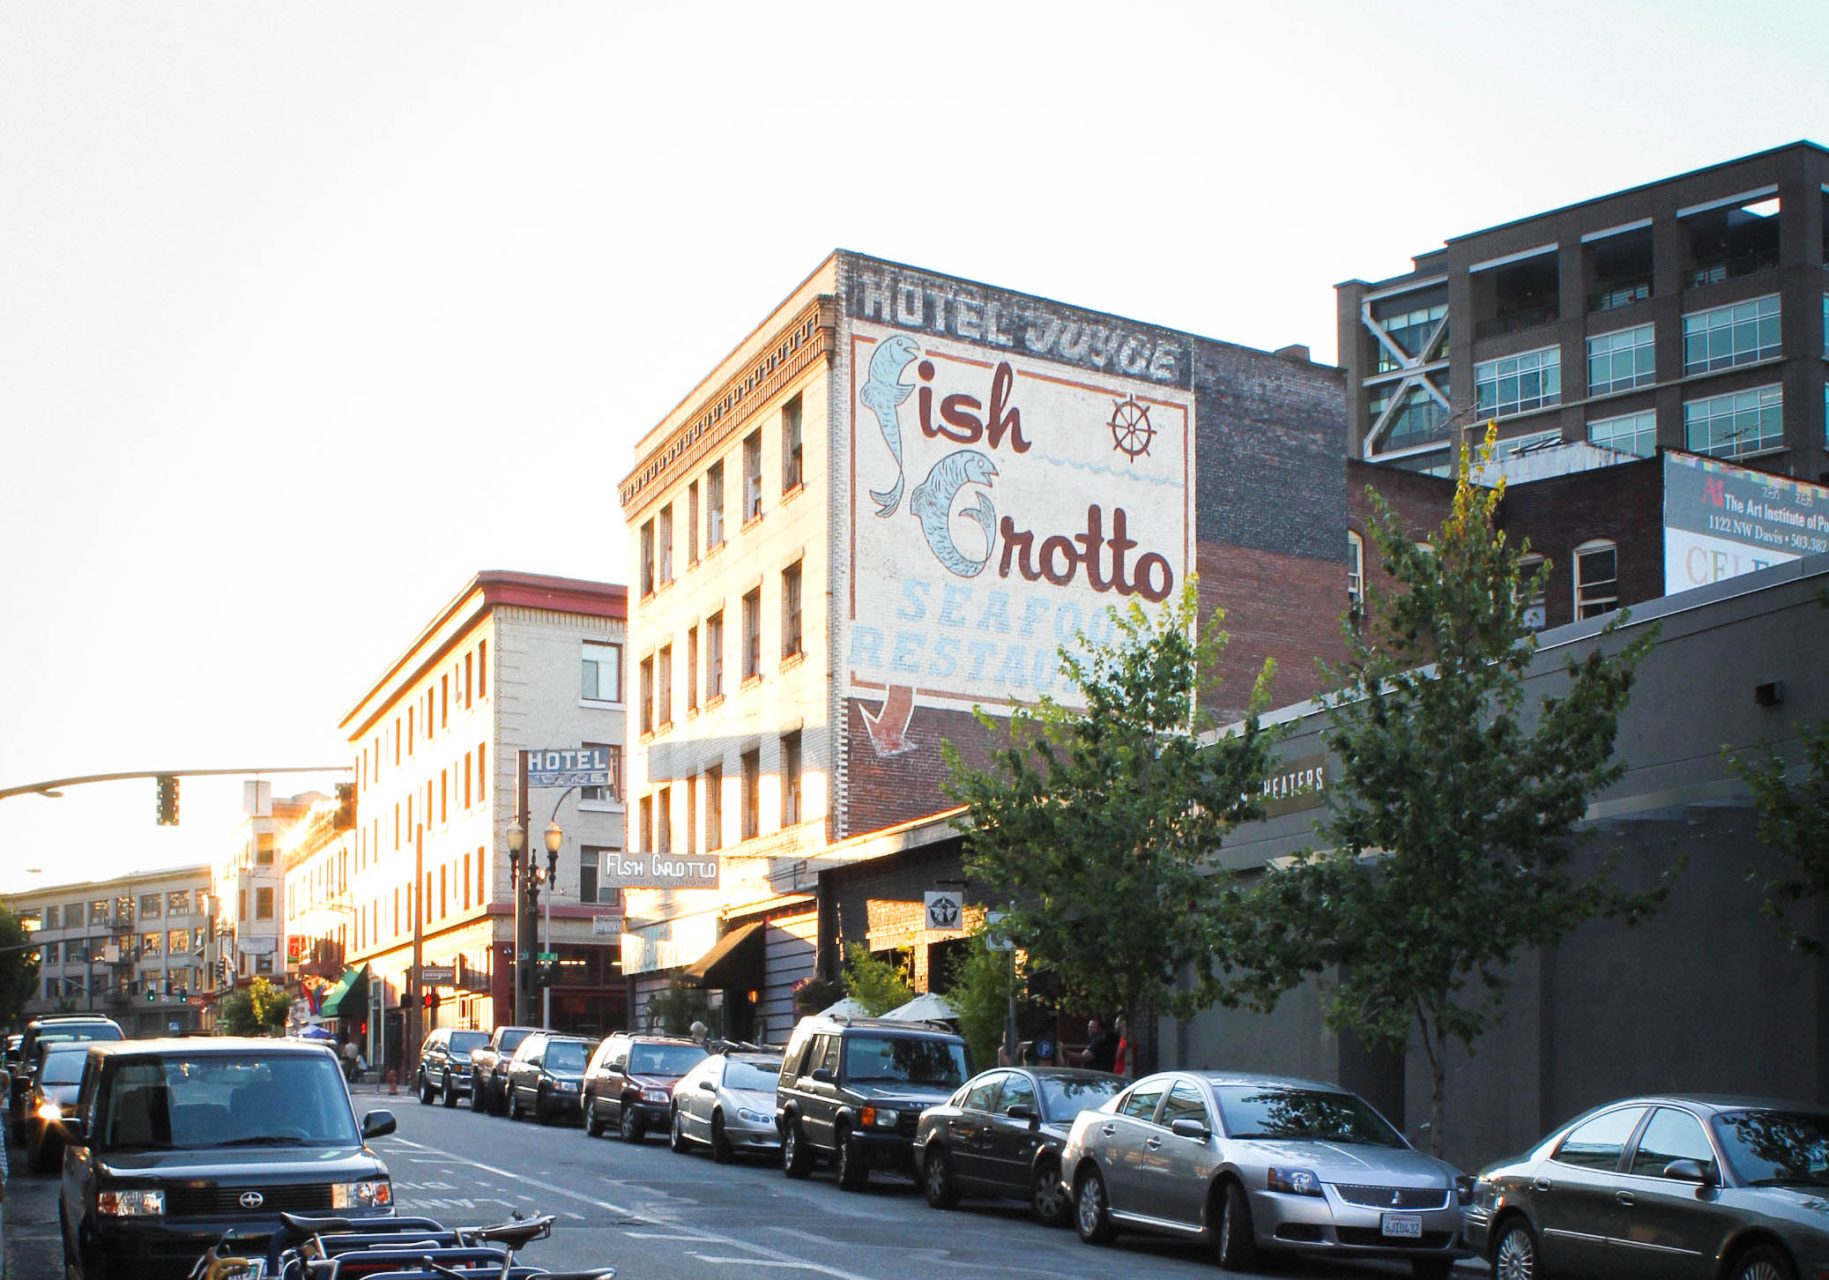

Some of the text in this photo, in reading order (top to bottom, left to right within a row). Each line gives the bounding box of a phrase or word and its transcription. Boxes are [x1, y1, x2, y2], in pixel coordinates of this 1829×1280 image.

[856, 268, 1013, 346] HOTEL
[1709, 514, 1731, 532] 1122
[1733, 520, 1753, 537] NW
[1754, 525, 1784, 544] Davis
[1725, 493, 1744, 513] The
[1746, 499, 1763, 518] Art
[1764, 503, 1805, 527] Institute
[1807, 514, 1817, 530] of
[896, 578, 1126, 648] SEAFOO
[527, 750, 606, 771] HOTEL
[1257, 766, 1323, 801] HEATERS
[606, 853, 716, 878] FISH GROTTO
